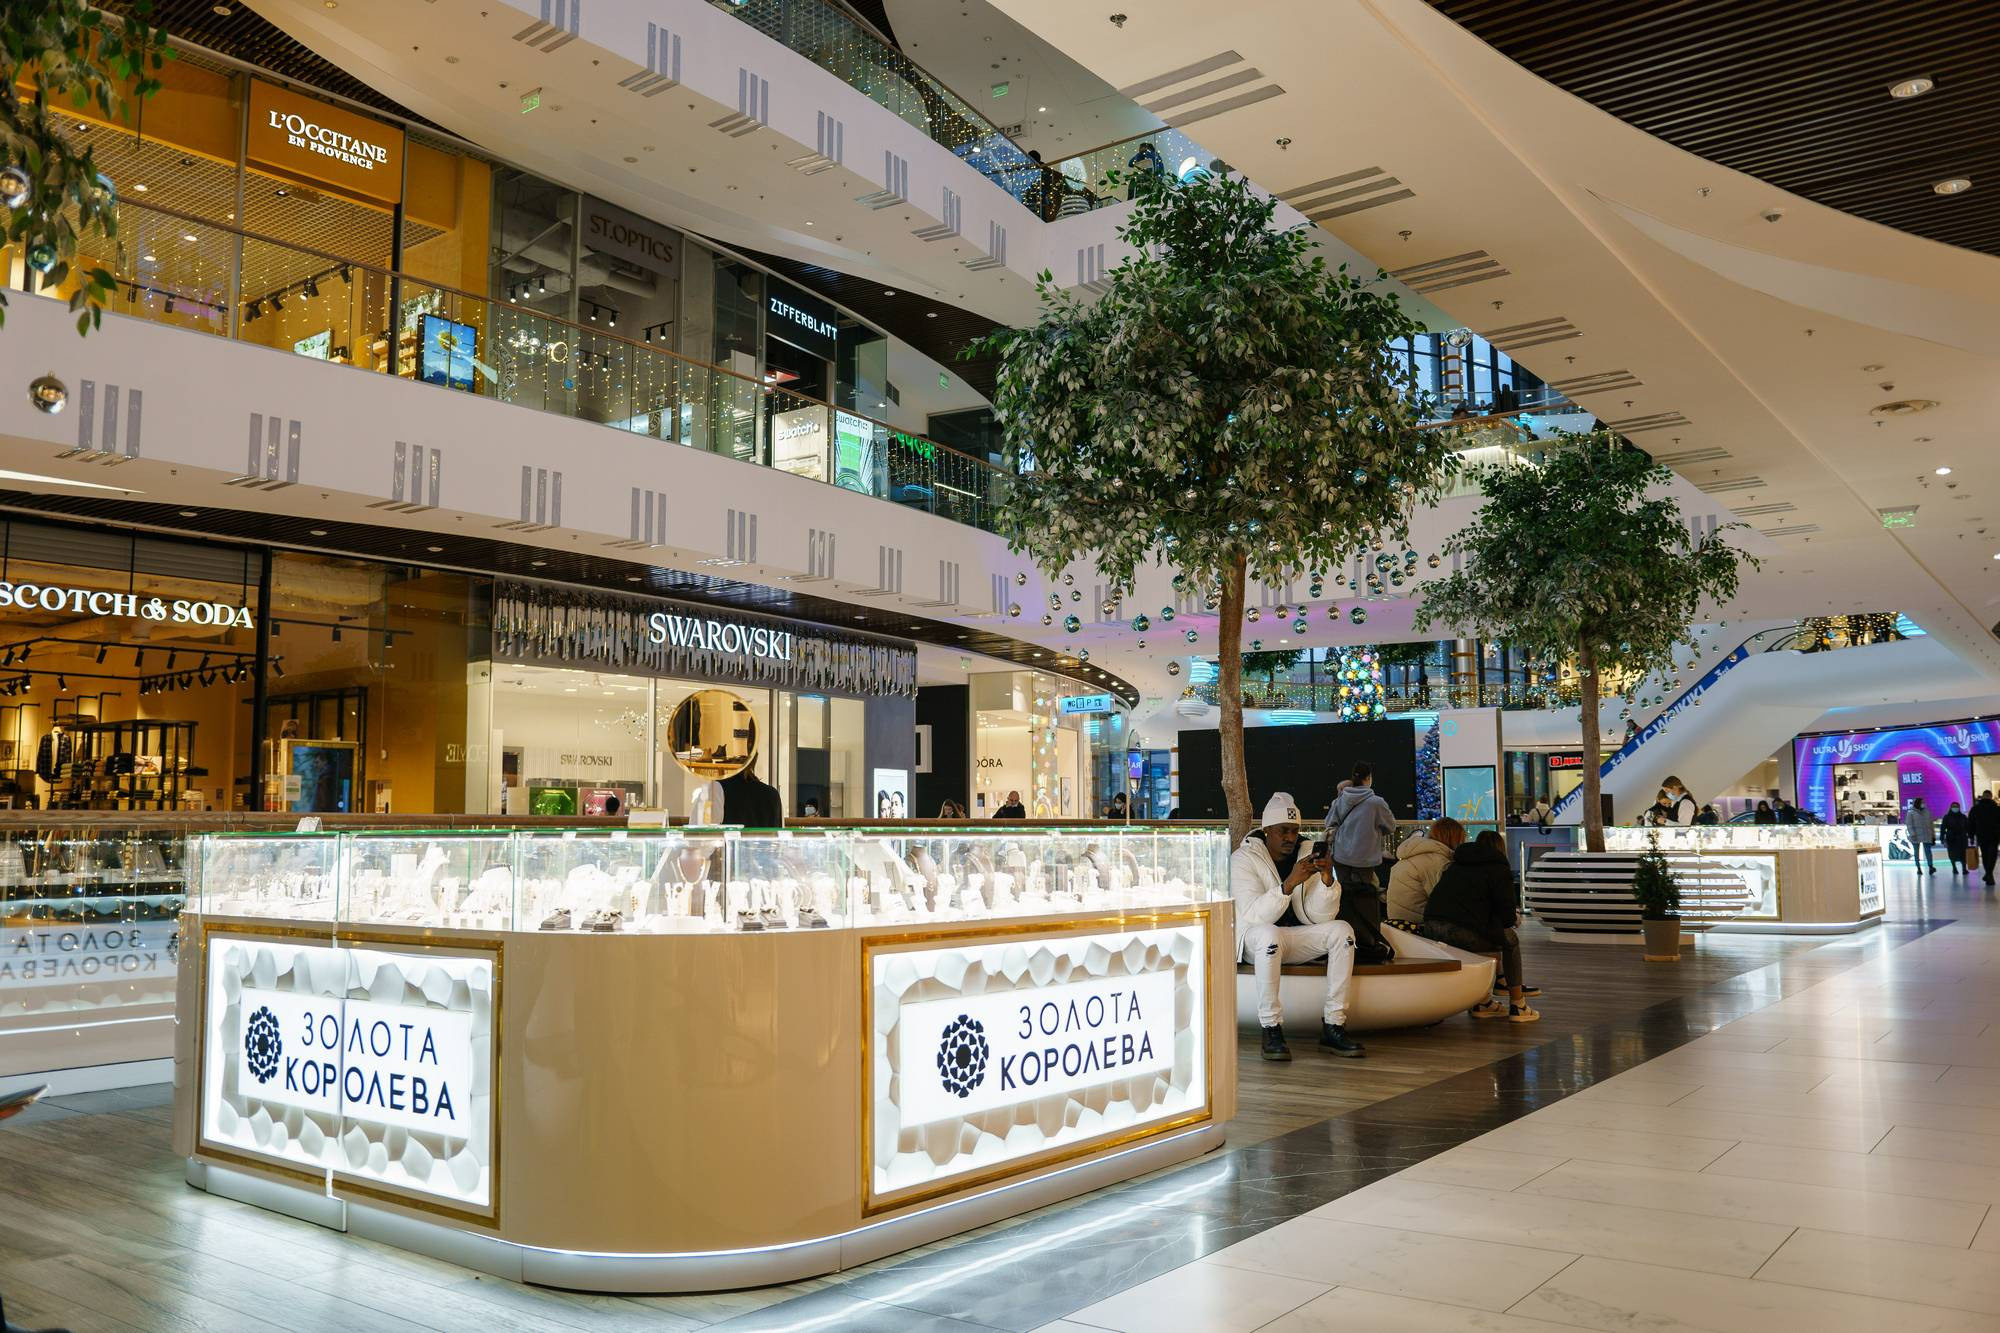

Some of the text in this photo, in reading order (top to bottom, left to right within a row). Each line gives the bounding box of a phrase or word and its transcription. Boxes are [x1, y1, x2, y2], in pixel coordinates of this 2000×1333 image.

[269, 110, 387, 163] L'OCCITANE
[288, 134, 373, 170] EN PROVENCE
[590, 214, 673, 263] ST.OPTICS
[770, 297, 838, 341] ZIFFERBLATT
[0, 581, 254, 629] SCOTCH & SODA
[649, 612, 791, 660] SWAROVSKI
[560, 754, 613, 766] SWROVSKI
[1813, 743, 1875, 754] ULTRA SHOP
[1937, 733, 1989, 745] ULTRA SHOP
[301, 1012, 438, 1065] ЗОЛОТА
[1019, 990, 1142, 1039] ЗОЛОТА
[1001, 1030, 1154, 1091] КОРОЛЕВА
[286, 1056, 455, 1120] КОРОЛЕВА
